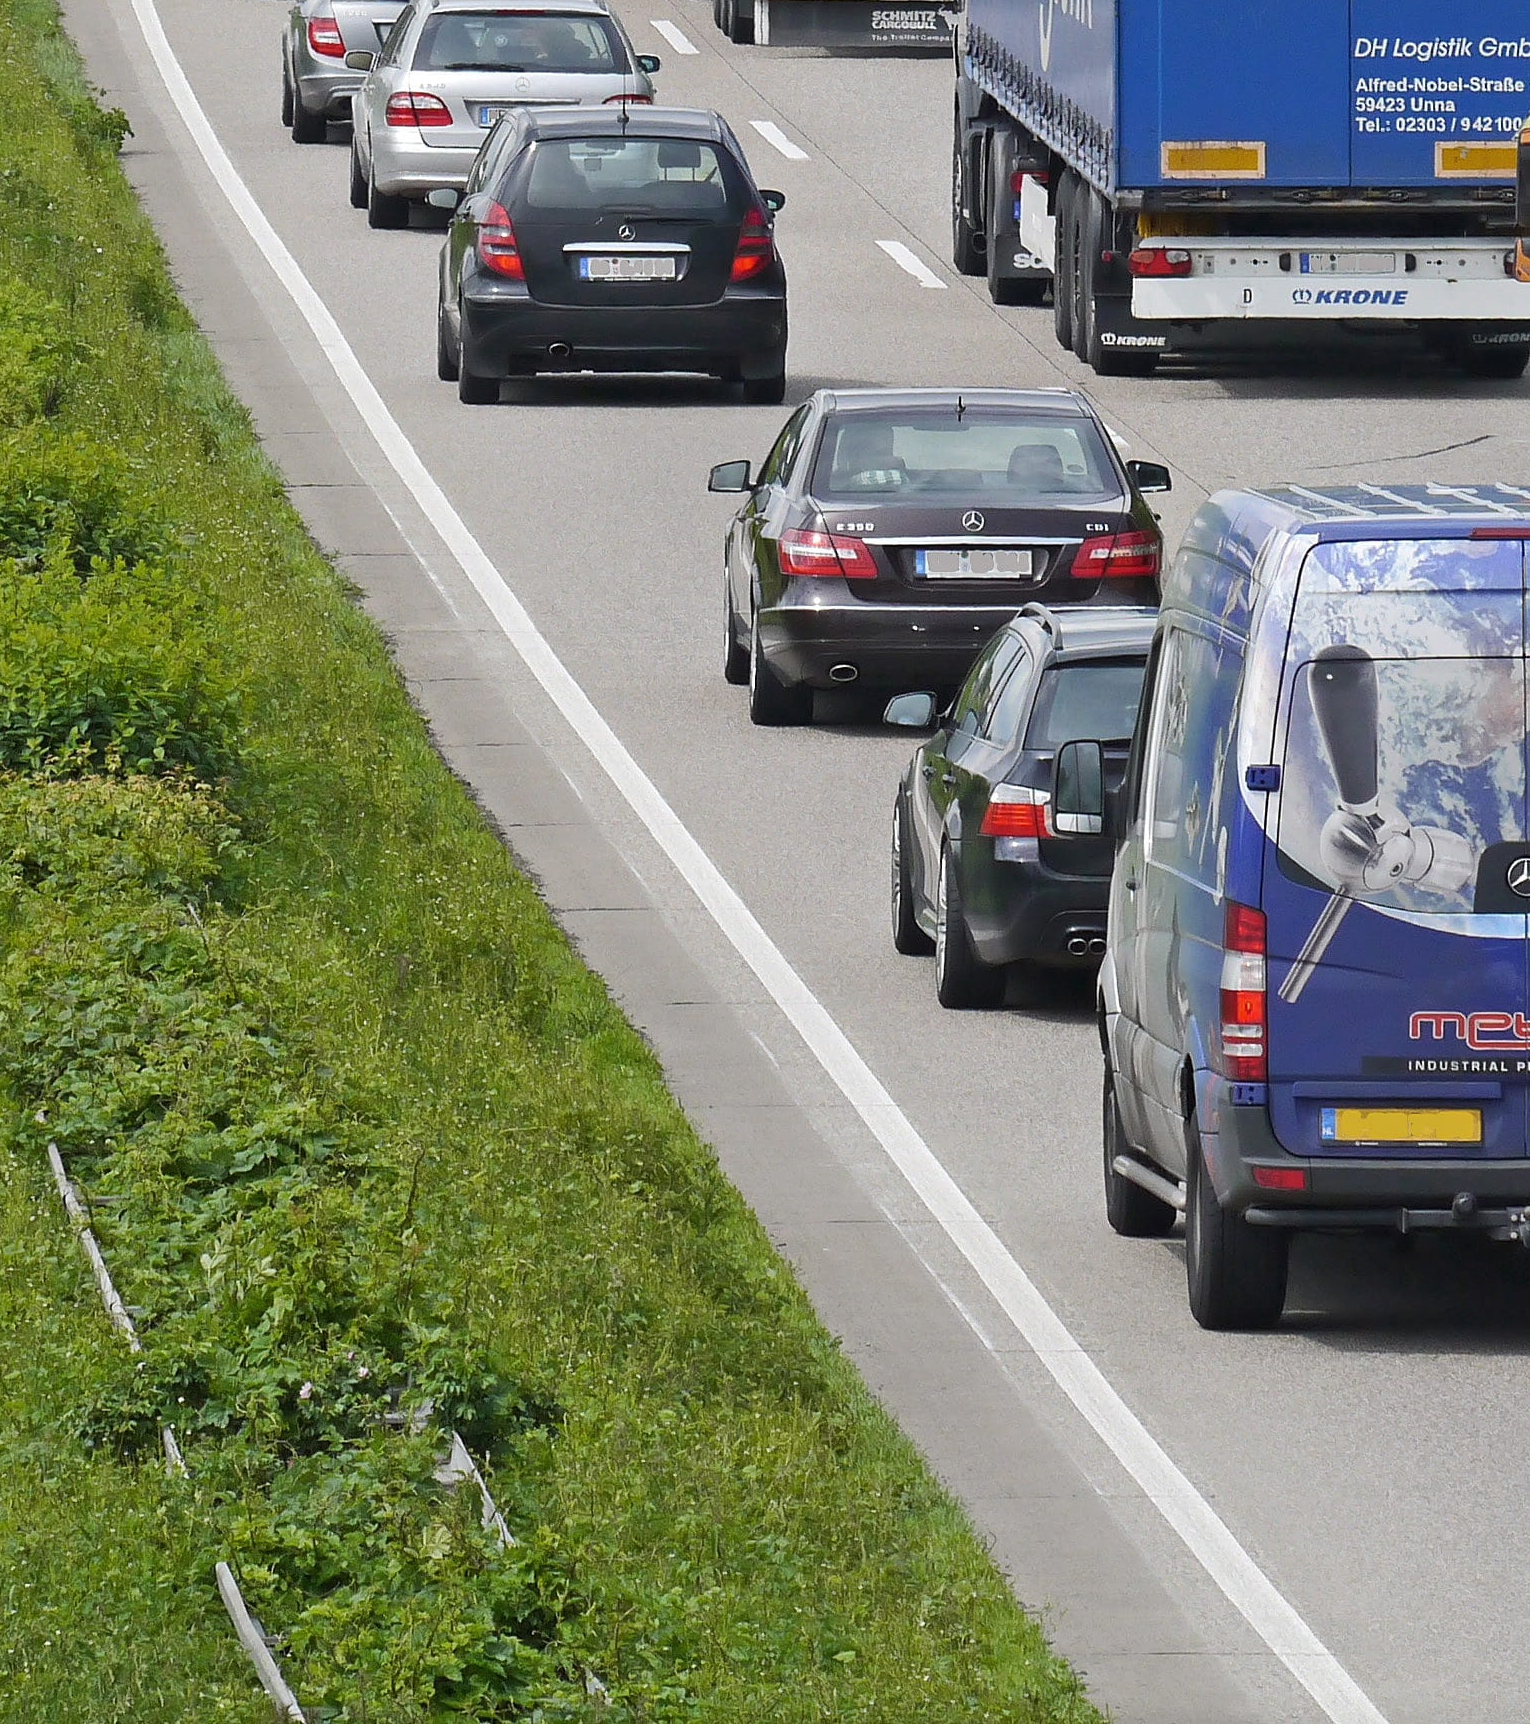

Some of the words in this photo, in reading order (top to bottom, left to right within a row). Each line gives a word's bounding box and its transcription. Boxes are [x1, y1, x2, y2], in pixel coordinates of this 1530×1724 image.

[871, 10, 936, 21] SCHMITZ
[871, 21, 937, 30] CARGOBULL
[1354, 38, 1388, 58] DH
[1393, 37, 1473, 62] Logistik
[1355, 77, 1525, 93] Alfred-Nobel-Straße
[1355, 98, 1406, 112] 59423
[1411, 98, 1456, 112] Unna
[1355, 117, 1391, 132] Tel.:
[1396, 117, 1447, 132] 02303
[1243, 288, 1253, 304] D
[1315, 289, 1409, 306] KRONE
[1116, 334, 1167, 347] KRONE
[1408, 1061, 1509, 1073] INDUSTRIAL
